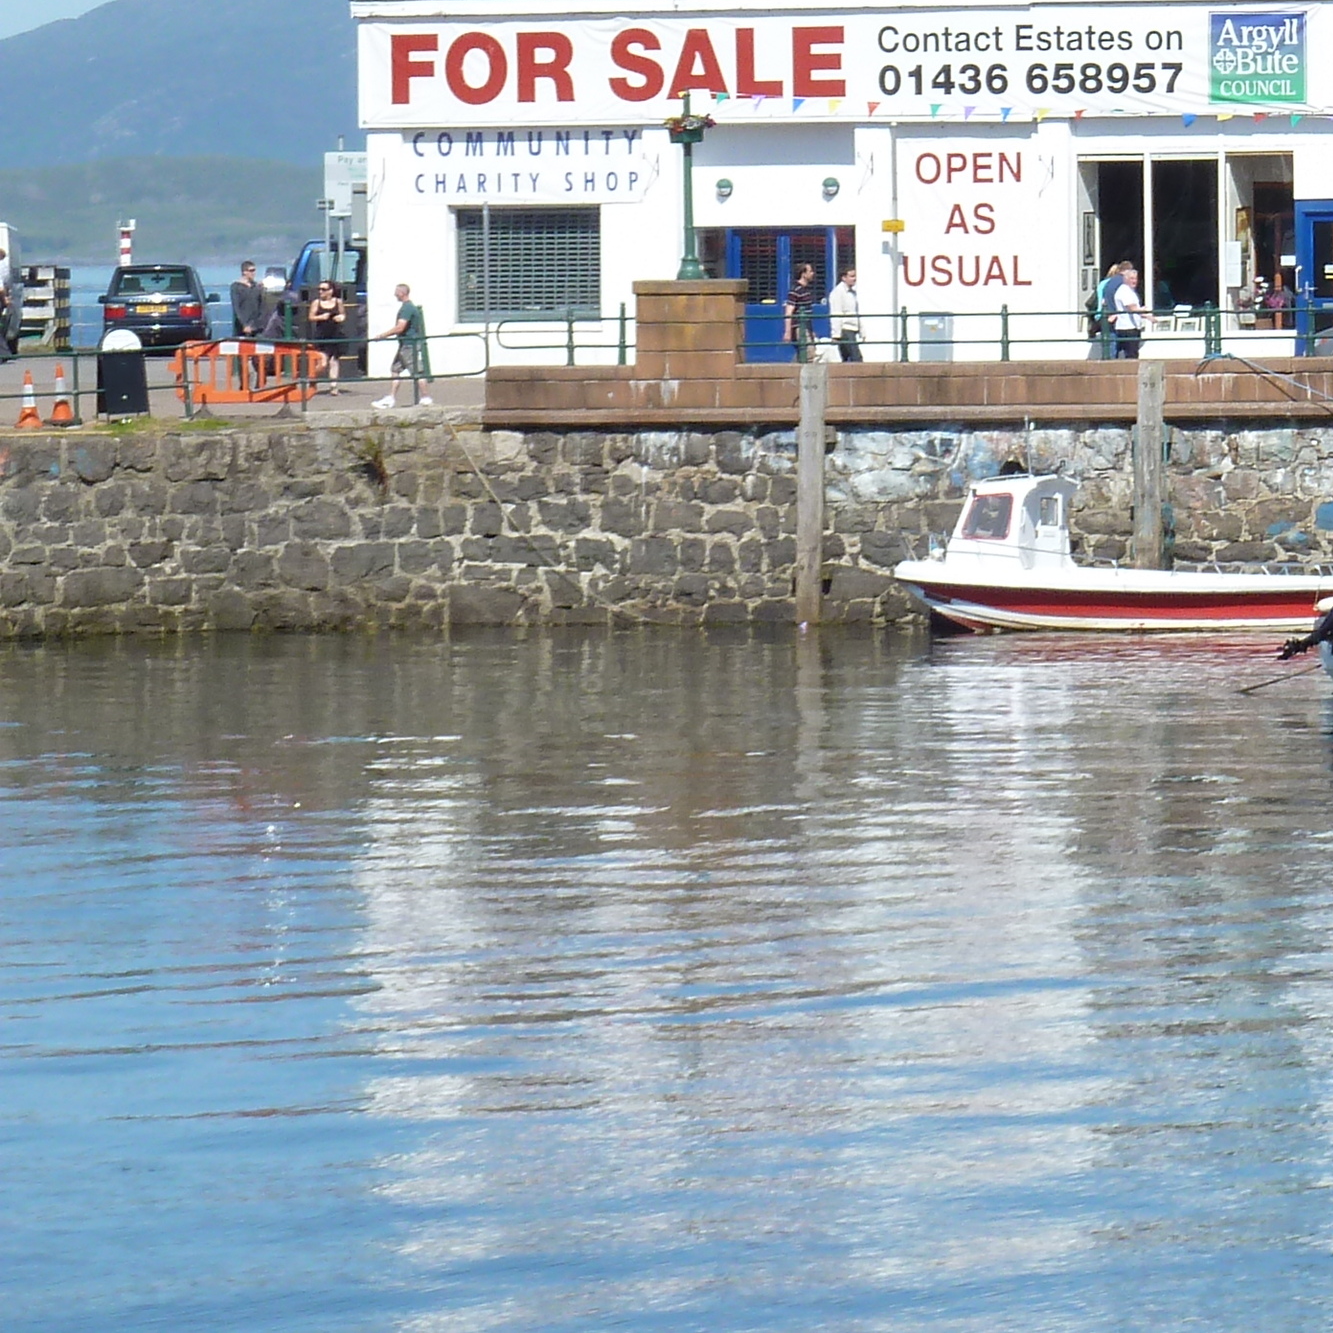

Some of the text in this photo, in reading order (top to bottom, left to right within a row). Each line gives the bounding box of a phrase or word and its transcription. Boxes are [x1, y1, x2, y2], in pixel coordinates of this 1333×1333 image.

[878, 24, 1183, 53] Contact Estates on
[1216, 18, 1299, 53] Argyll
[391, 26, 847, 105] FOR SALE
[1235, 48, 1299, 75] Bute
[878, 62, 1184, 96] 01436 658957
[1219, 80, 1296, 96] COUNCIL
[411, 129, 638, 157] COMMUNITY
[337, 154, 354, 165] Pay
[915, 152, 1022, 185] OPEN
[415, 171, 640, 193] CHARITY SHOP
[944, 202, 996, 235] AS
[902, 254, 1033, 287] USUAL
